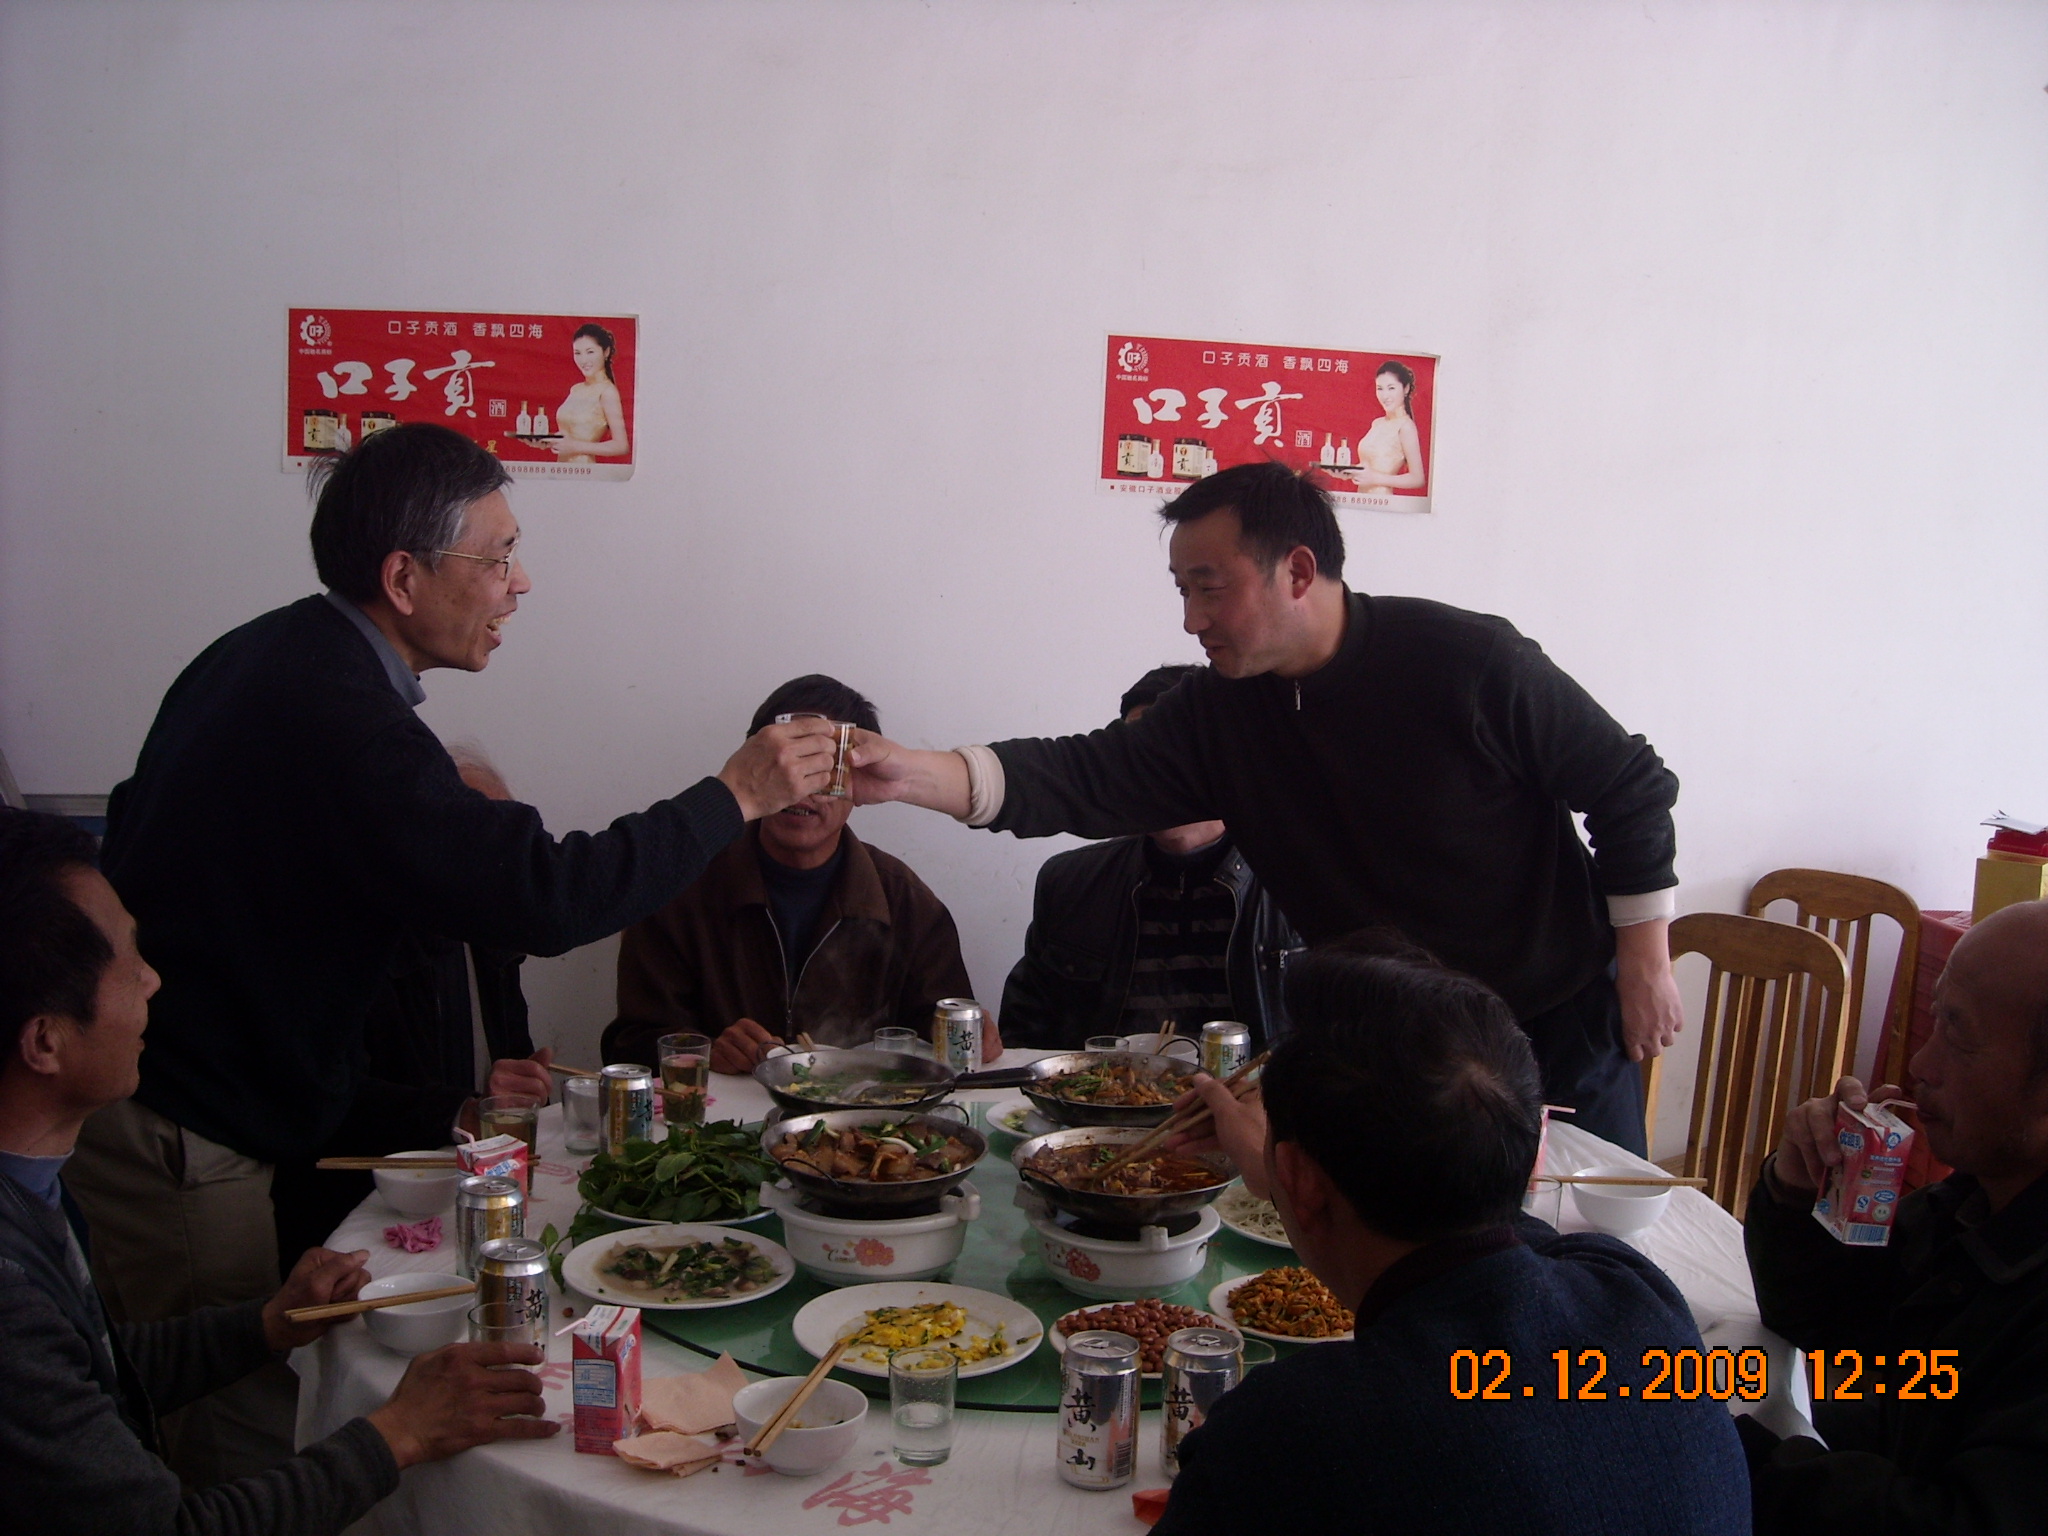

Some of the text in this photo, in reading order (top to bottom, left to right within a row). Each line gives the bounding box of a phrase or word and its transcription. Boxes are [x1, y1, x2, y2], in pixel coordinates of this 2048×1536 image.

[388, 320, 543, 339] 口子贡酒 香飘四海
[1203, 350, 1349, 374] 口子贡酒 香飘四海
